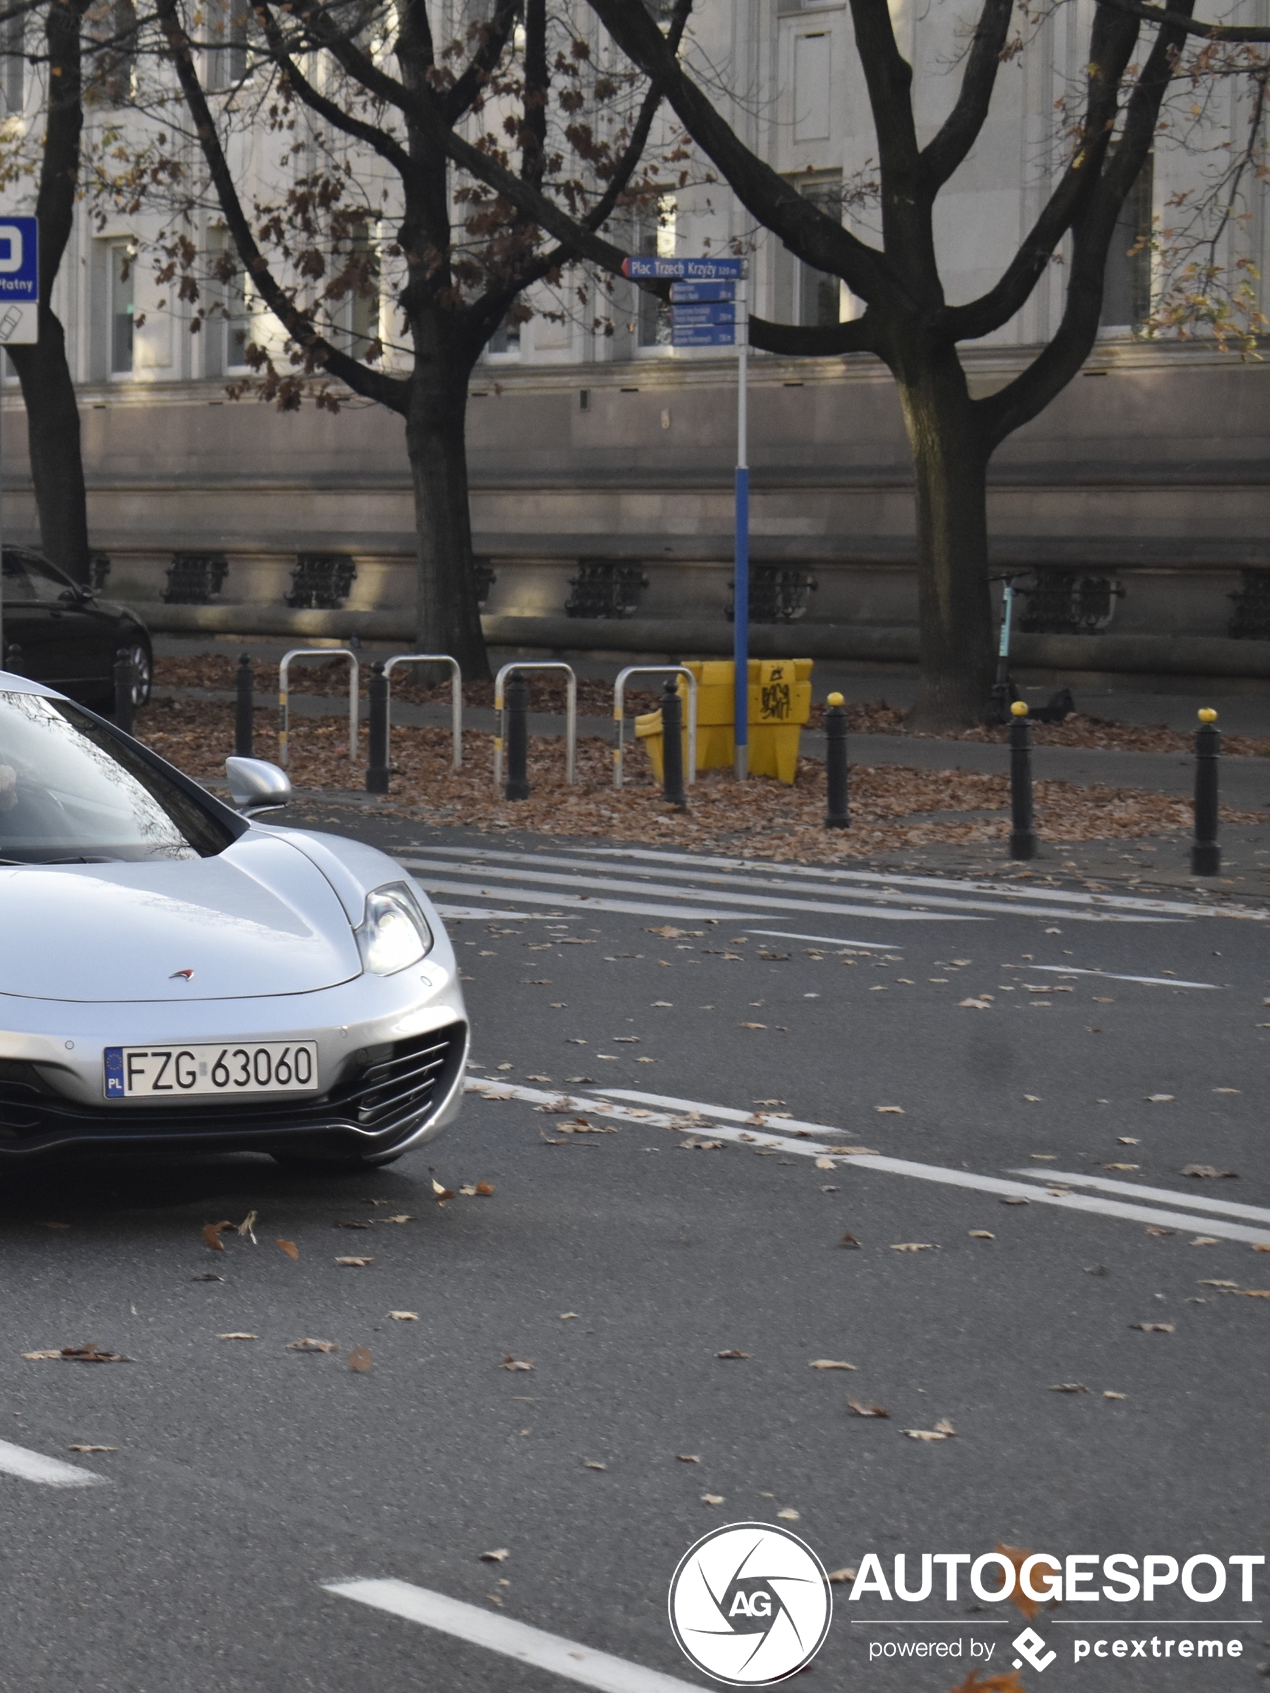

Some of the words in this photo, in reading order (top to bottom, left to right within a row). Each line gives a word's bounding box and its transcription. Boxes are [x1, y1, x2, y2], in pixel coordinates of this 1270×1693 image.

[631, 261, 651, 275] Plac
[654, 261, 684, 276] Trzech
[687, 261, 716, 277] Krzyży
[126, 1050, 197, 1091] FZG
[210, 1046, 313, 1087] 63060
[108, 1078, 122, 1090] PL
